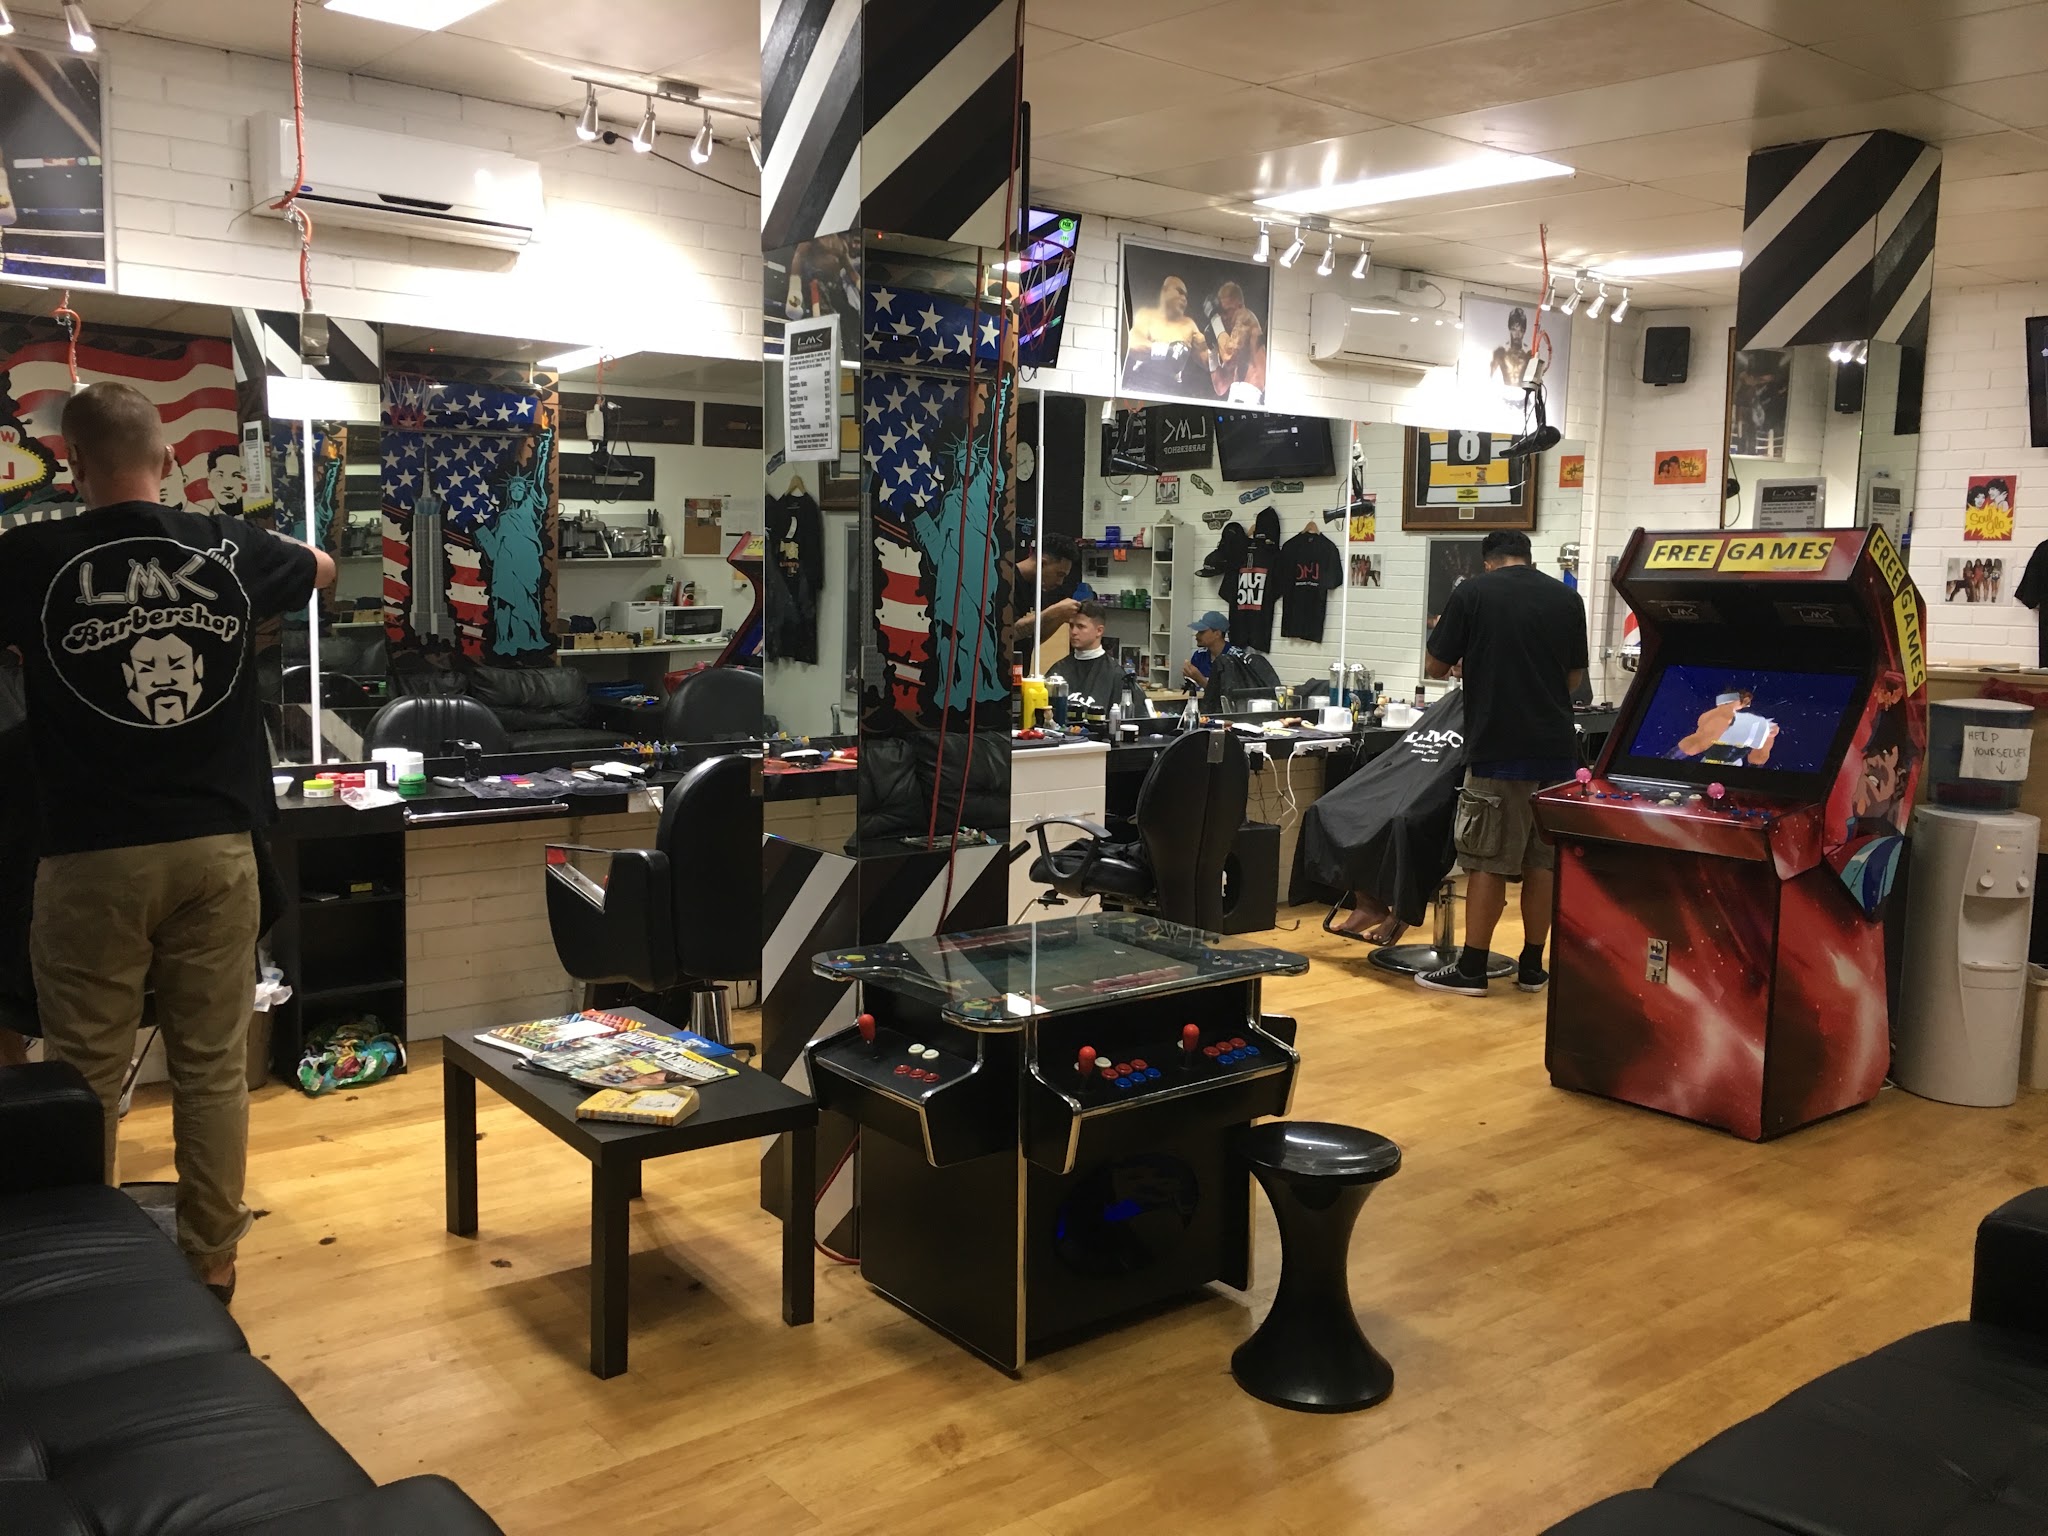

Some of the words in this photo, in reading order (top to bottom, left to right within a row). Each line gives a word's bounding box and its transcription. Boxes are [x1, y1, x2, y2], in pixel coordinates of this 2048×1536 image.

[1970, 509, 1993, 525] Soul
[1986, 516, 2005, 534] glo
[1653, 545, 1715, 561] FREE
[1727, 542, 1832, 560] GAMES
[1872, 534, 1903, 590] FREE
[1901, 590, 1924, 688] GAMES
[62, 603, 240, 654] Barbershop
[1968, 731, 1999, 743] HELP
